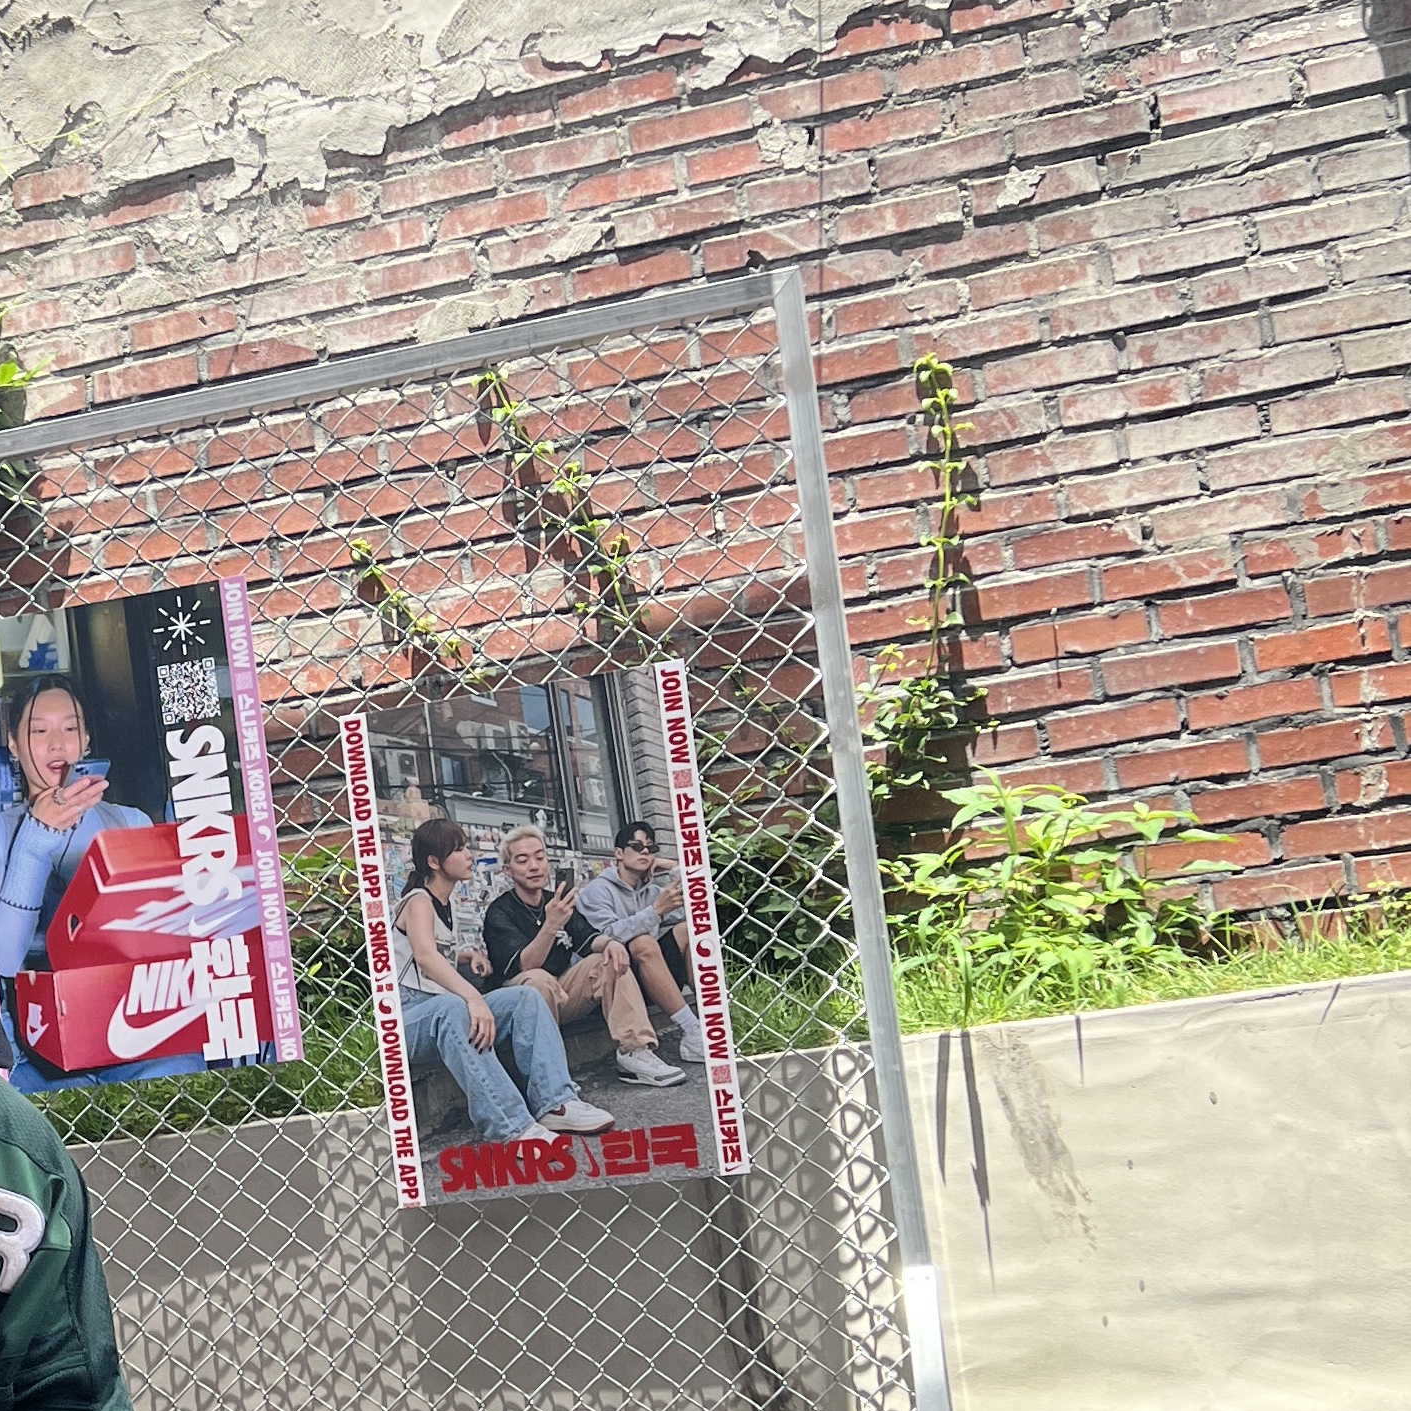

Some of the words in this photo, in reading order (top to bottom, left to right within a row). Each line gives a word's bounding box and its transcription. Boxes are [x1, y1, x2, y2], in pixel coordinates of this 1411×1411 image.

[223, 580, 244, 620] JOIN
[229, 624, 249, 668] NOW
[660, 667, 683, 712] JOIN
[237, 693, 260, 761] 스니커즈
[666, 716, 690, 765] NOW
[246, 768, 268, 823] KOREA
[343, 719, 372, 821] DOWNLOAD
[166, 725, 242, 904] SNKRS
[676, 792, 702, 867] 스니커즈
[356, 825, 376, 857] THE
[256, 848, 276, 889] JOIN
[361, 861, 381, 898] APP
[261, 892, 282, 937] NOW
[687, 875, 712, 935] KOREA
[368, 920, 390, 973] SNKRS
[189, 934, 260, 1061] 한국
[269, 961, 293, 1029] 스니커즈
[698, 961, 721, 1007] JOIN
[704, 1011, 728, 1061] NOW
[380, 1018, 408, 1121] DOWNLOAD
[393, 1125, 413, 1158] THE
[715, 1087, 742, 1163] 스니커즈
[398, 1162, 418, 1200] APP
[439, 1136, 577, 1193] SNKRS
[601, 1124, 699, 1178] 한국
